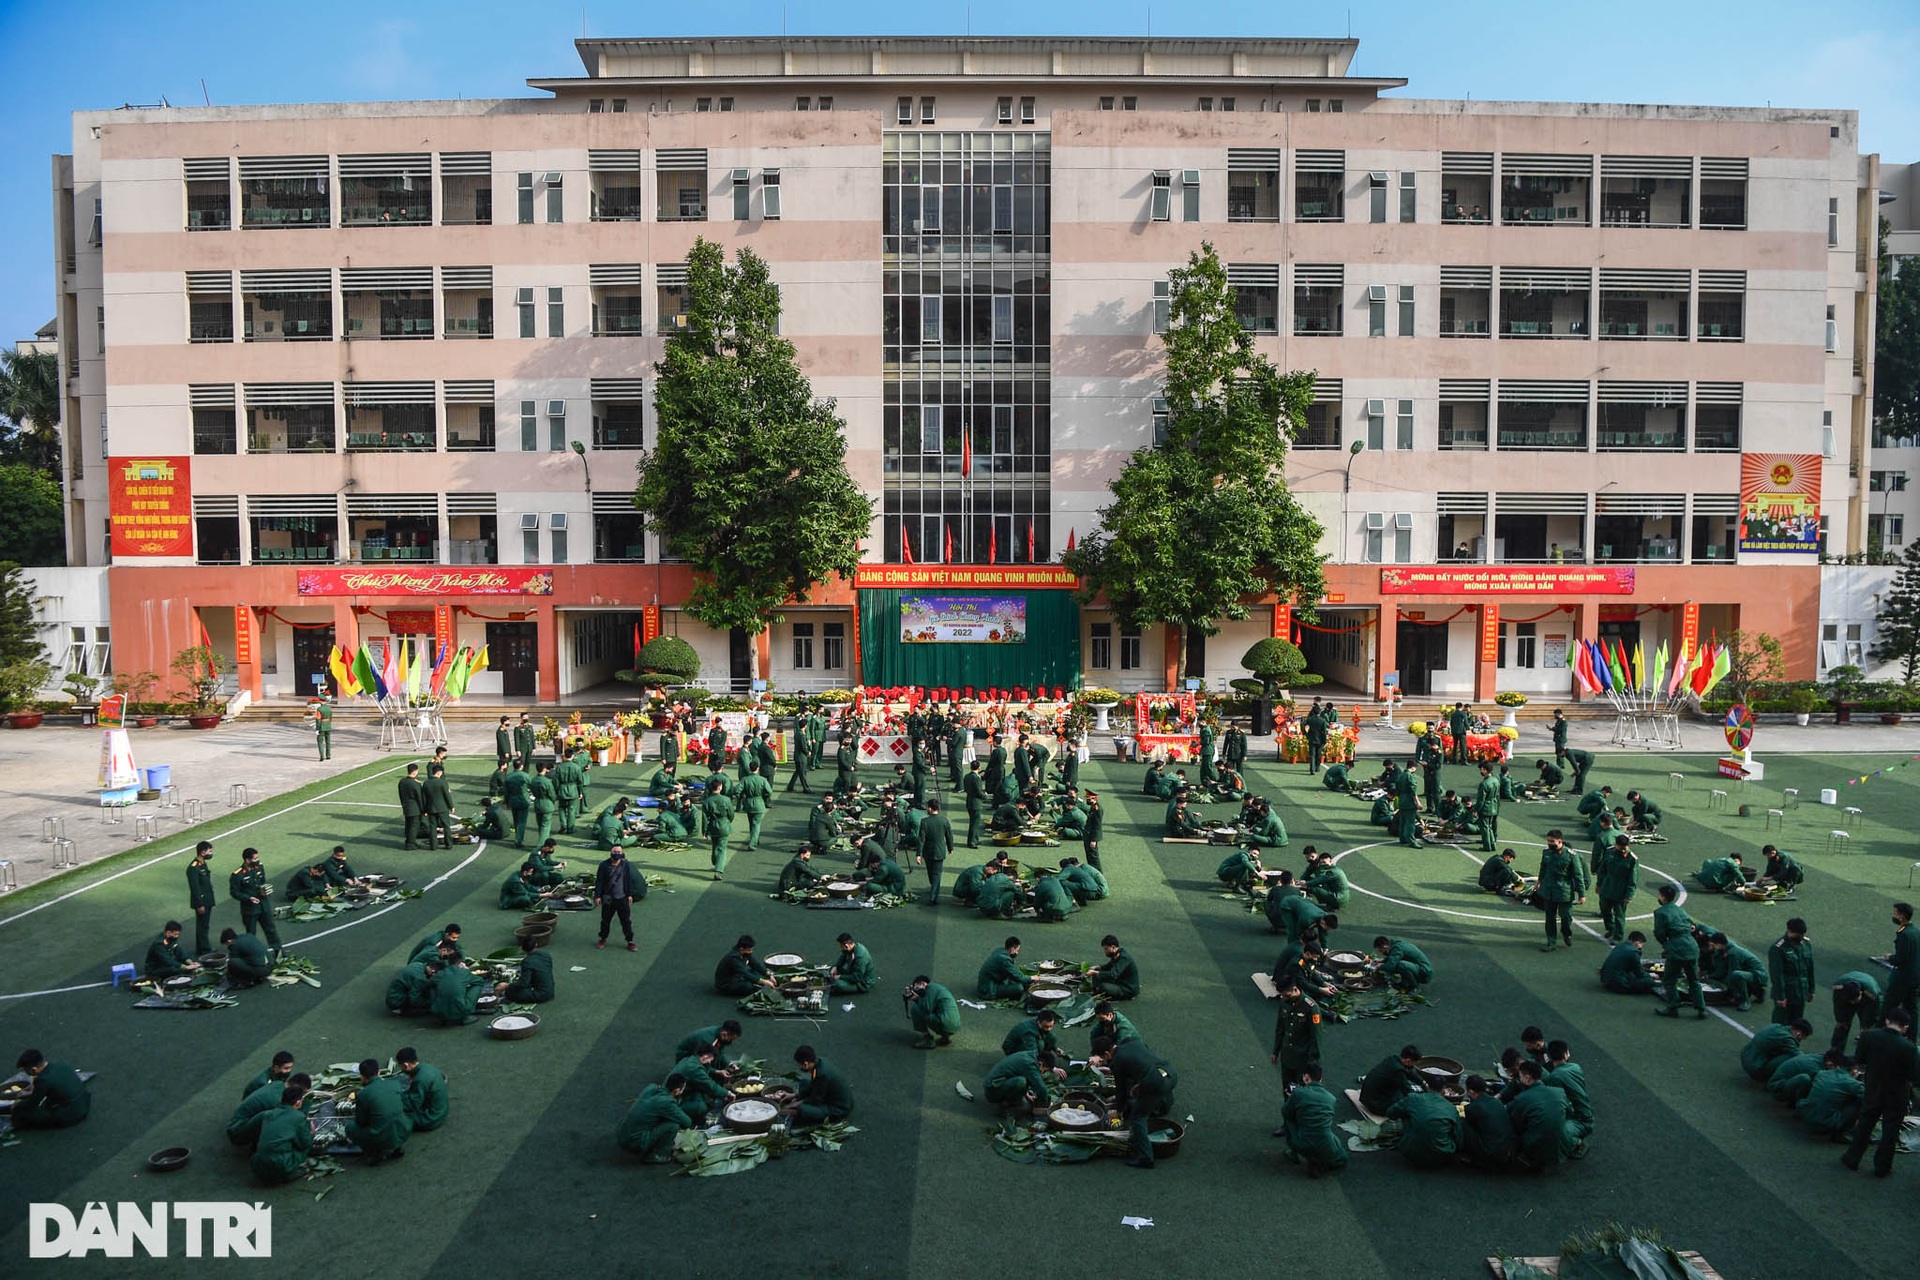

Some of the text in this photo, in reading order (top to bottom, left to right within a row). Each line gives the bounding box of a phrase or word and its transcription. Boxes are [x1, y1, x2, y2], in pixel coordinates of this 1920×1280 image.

[859, 569, 1075, 584] ĐẢNG CỘNG SẢN VIỆT NAM QUANG VINH MUÔN NĂM
[1411, 573, 1434, 581] MỪNG
[1436, 573, 1451, 581] ĐẤT
[1453, 573, 1474, 581] NƯỚC
[1510, 573, 1533, 581] MỪNG
[1559, 574, 1584, 582] QUANG
[340, 573, 509, 592] Chúc Mừng Năm Mới
[1464, 582, 1554, 590] MỪNG XUÂN NHÂM DẦN
[953, 628, 972, 636] 2022
